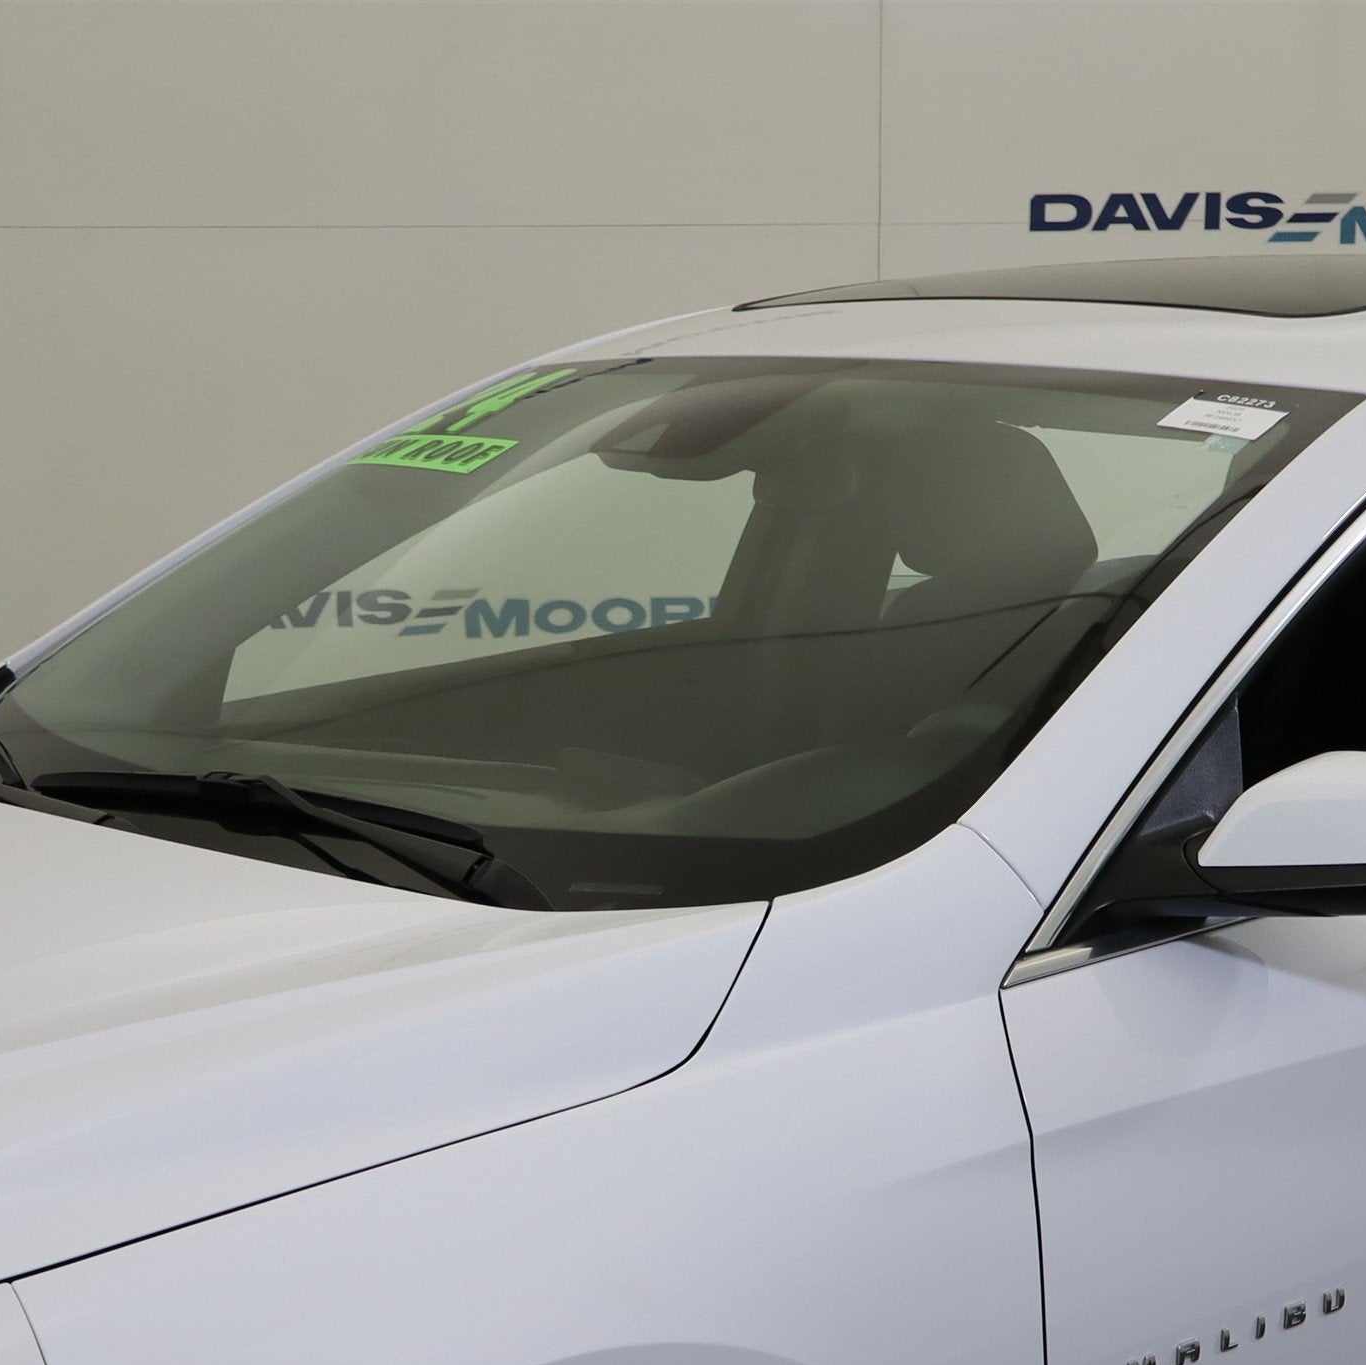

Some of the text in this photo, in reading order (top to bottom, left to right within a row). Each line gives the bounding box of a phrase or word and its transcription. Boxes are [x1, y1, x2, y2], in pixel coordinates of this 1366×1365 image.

[1029, 191, 1285, 233] DAVIS
[400, 440, 506, 467] ROOF
[270, 589, 718, 639] VIS MOOR
